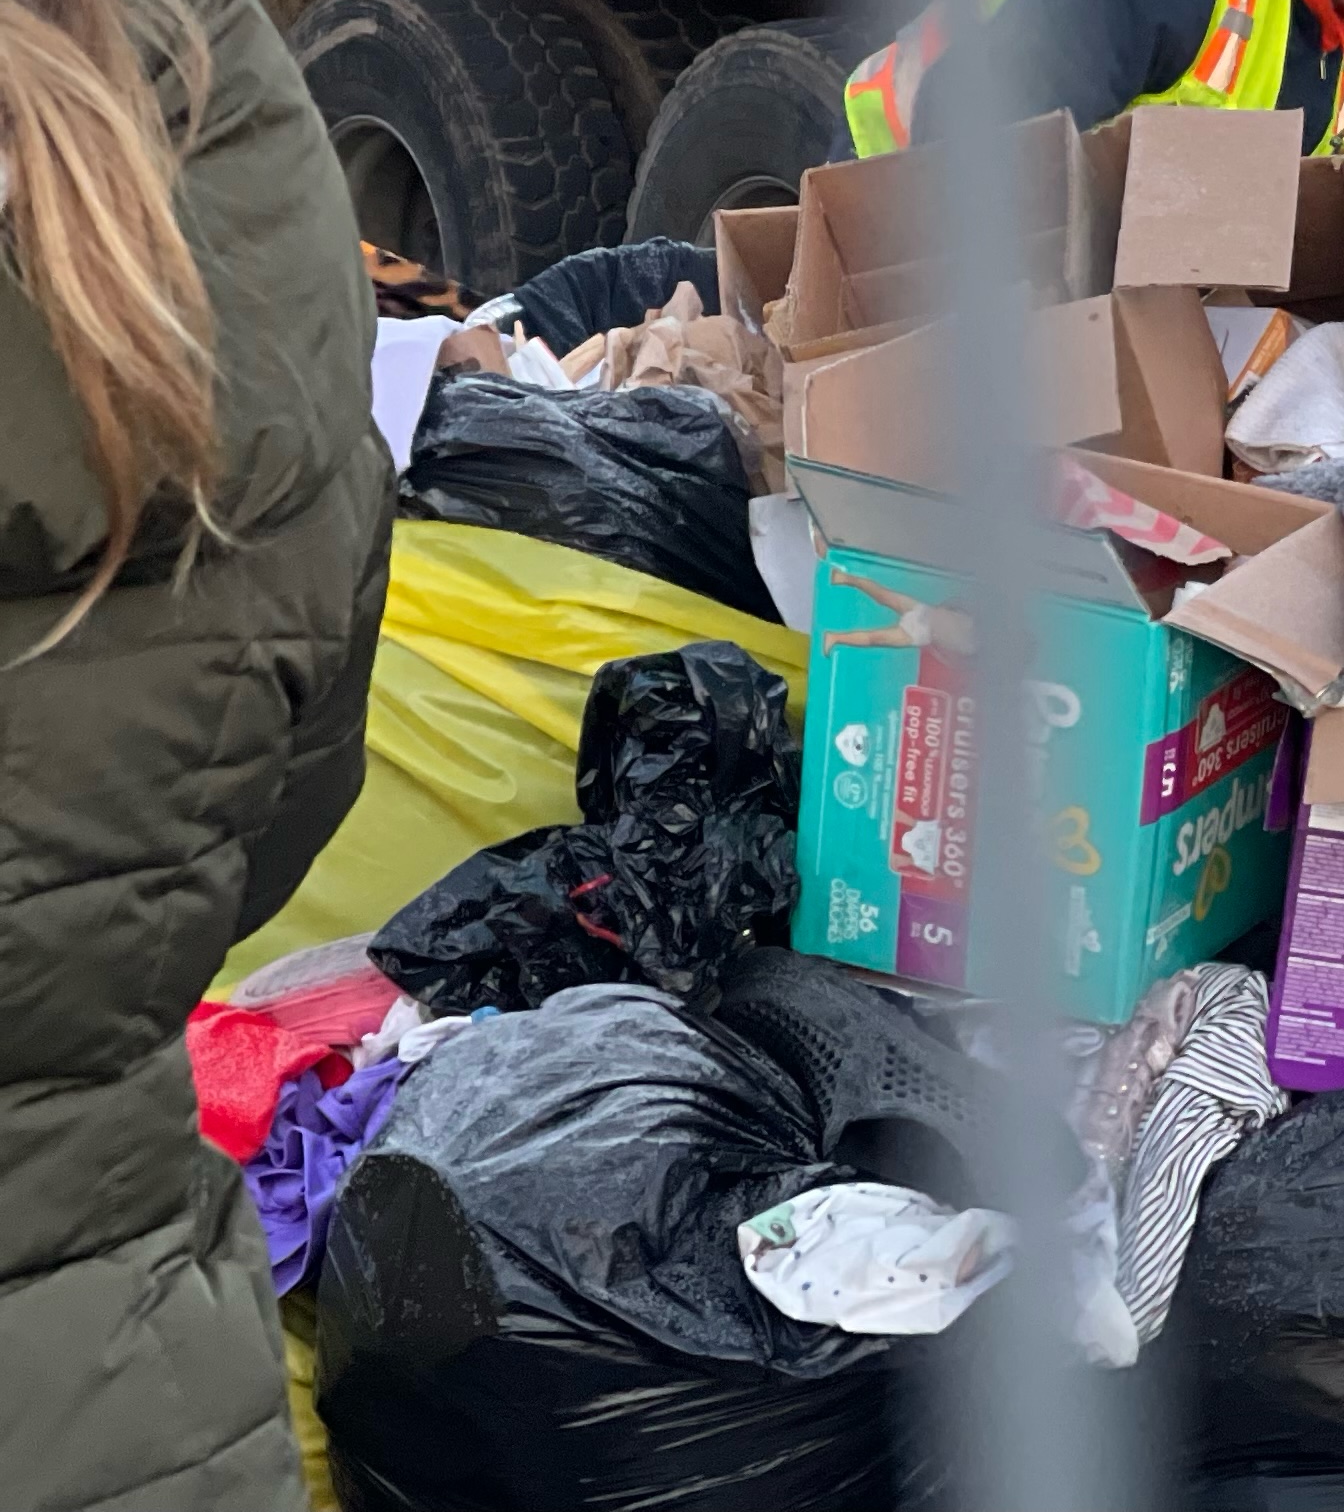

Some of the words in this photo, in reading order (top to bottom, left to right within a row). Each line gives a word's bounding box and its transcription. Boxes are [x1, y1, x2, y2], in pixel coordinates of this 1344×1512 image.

[903, 705, 922, 783] gap-free
[947, 695, 976, 820] cruisers
[902, 784, 918, 804] fit
[859, 902, 880, 933] 56
[923, 922, 953, 947] 5
